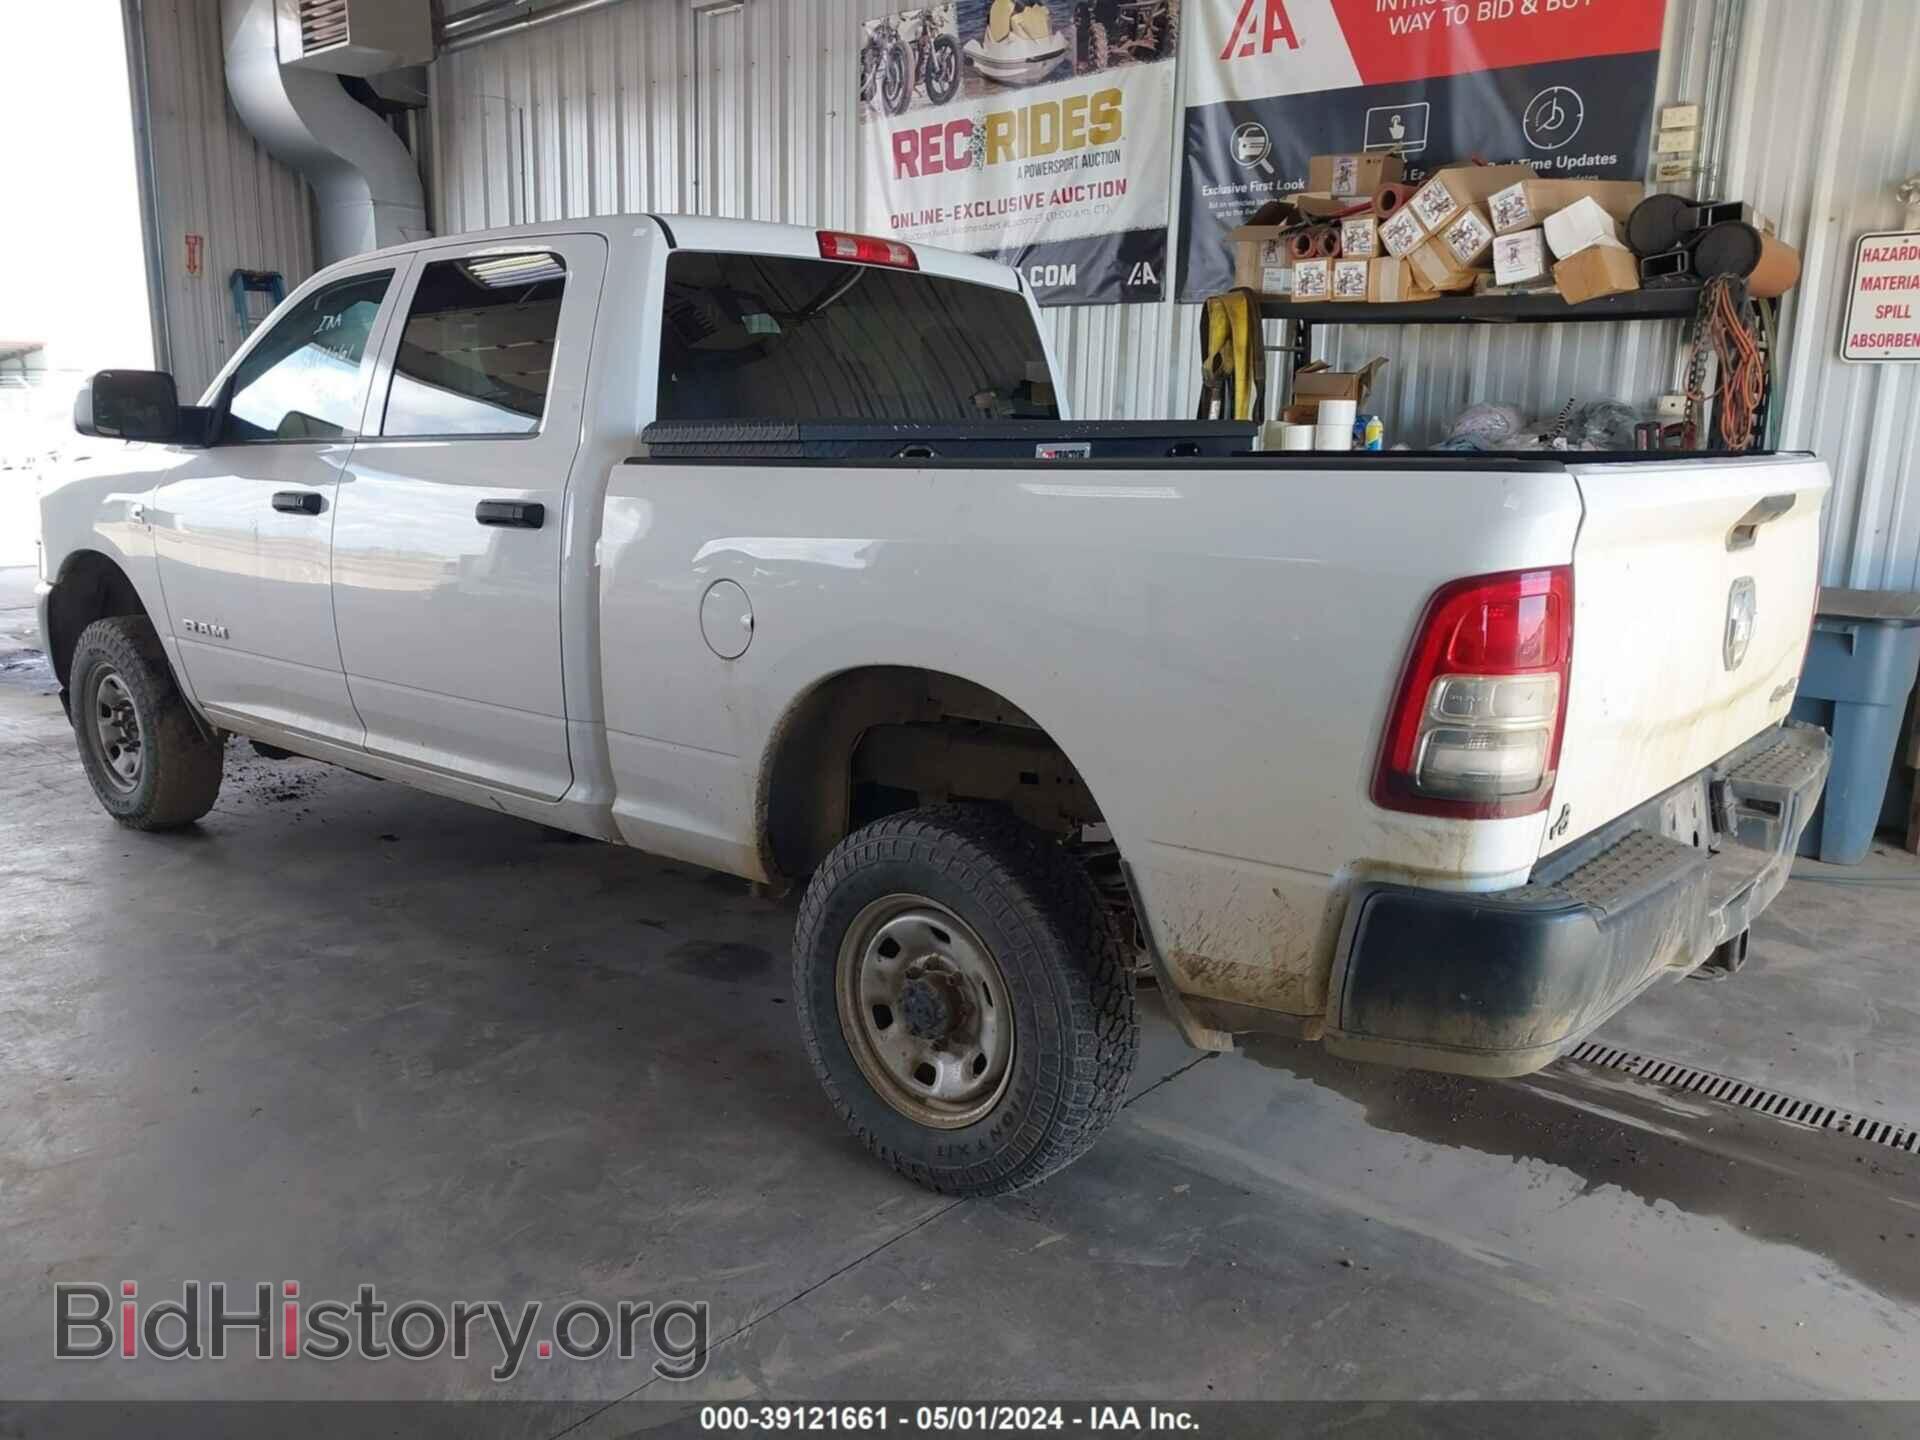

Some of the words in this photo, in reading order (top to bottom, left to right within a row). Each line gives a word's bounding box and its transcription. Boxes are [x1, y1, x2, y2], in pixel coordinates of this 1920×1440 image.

[1389, 11, 1436, 35] WAY
[1442, 5, 1469, 27] TO
[1477, 0, 1514, 22] BID
[1520, 0, 1538, 15] &
[892, 118, 974, 180] REC
[985, 87, 1123, 166] RIDES
[1024, 155, 1079, 178] POWERSPORT
[1081, 149, 1121, 169] AUCTION
[1556, 153, 1617, 170] Updates
[1202, 182, 1247, 196] Exclusive
[1250, 180, 1273, 192] First
[1276, 178, 1305, 191] Look
[889, 192, 1045, 229] ONLINE-EXCLUSIVE
[1049, 178, 1127, 206] AUCTION
[1862, 246, 1920, 262] HAZARD
[1860, 275, 1920, 291] MATERIA
[1875, 304, 1911, 319] SPILL
